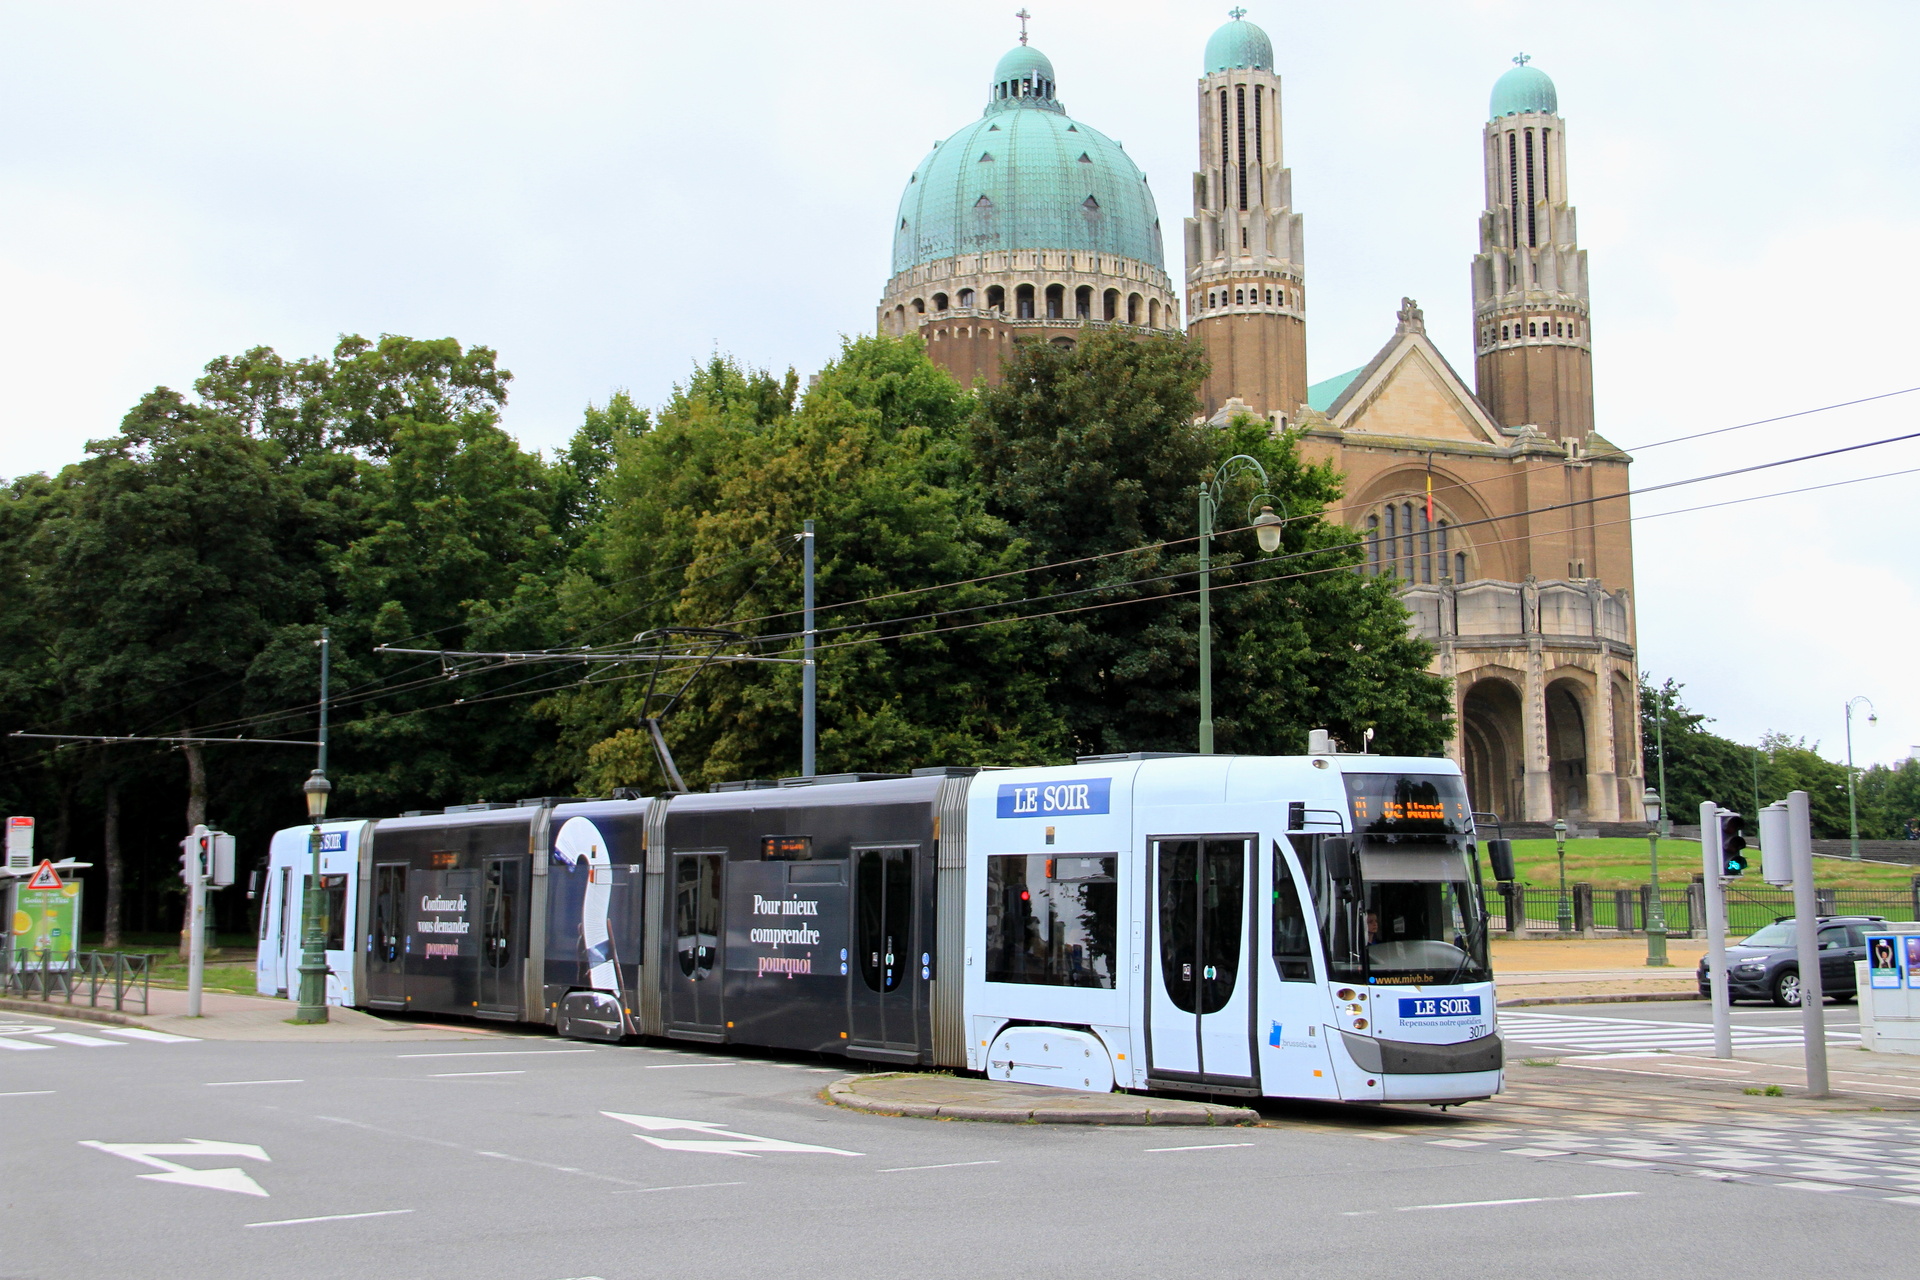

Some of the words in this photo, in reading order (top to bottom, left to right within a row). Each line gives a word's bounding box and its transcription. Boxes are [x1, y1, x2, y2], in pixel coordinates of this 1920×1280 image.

[1013, 787, 1038, 813] LE
[1043, 784, 1090, 812] SOIR
[324, 834, 342, 850] SOIR
[421, 894, 457, 911] Continuez
[457, 893, 467, 911] de
[753, 894, 780, 915] Pour
[781, 893, 818, 916] mieux
[417, 920, 434, 933] vous
[434, 916, 470, 934] demander
[750, 922, 820, 949] comprendre
[425, 938, 459, 960] pourquoi
[758, 951, 812, 979] pourquoi
[1375, 974, 1434, 985] www.mivb.be
[1414, 1000, 1436, 1015] LE
[1439, 998, 1471, 1015] SOIR
[1399, 1019, 1439, 1028] Repensons
[1439, 1018, 1457, 1027] notre
[1456, 1017, 1482, 1028] quotidien
[1469, 1024, 1487, 1039] 3071
